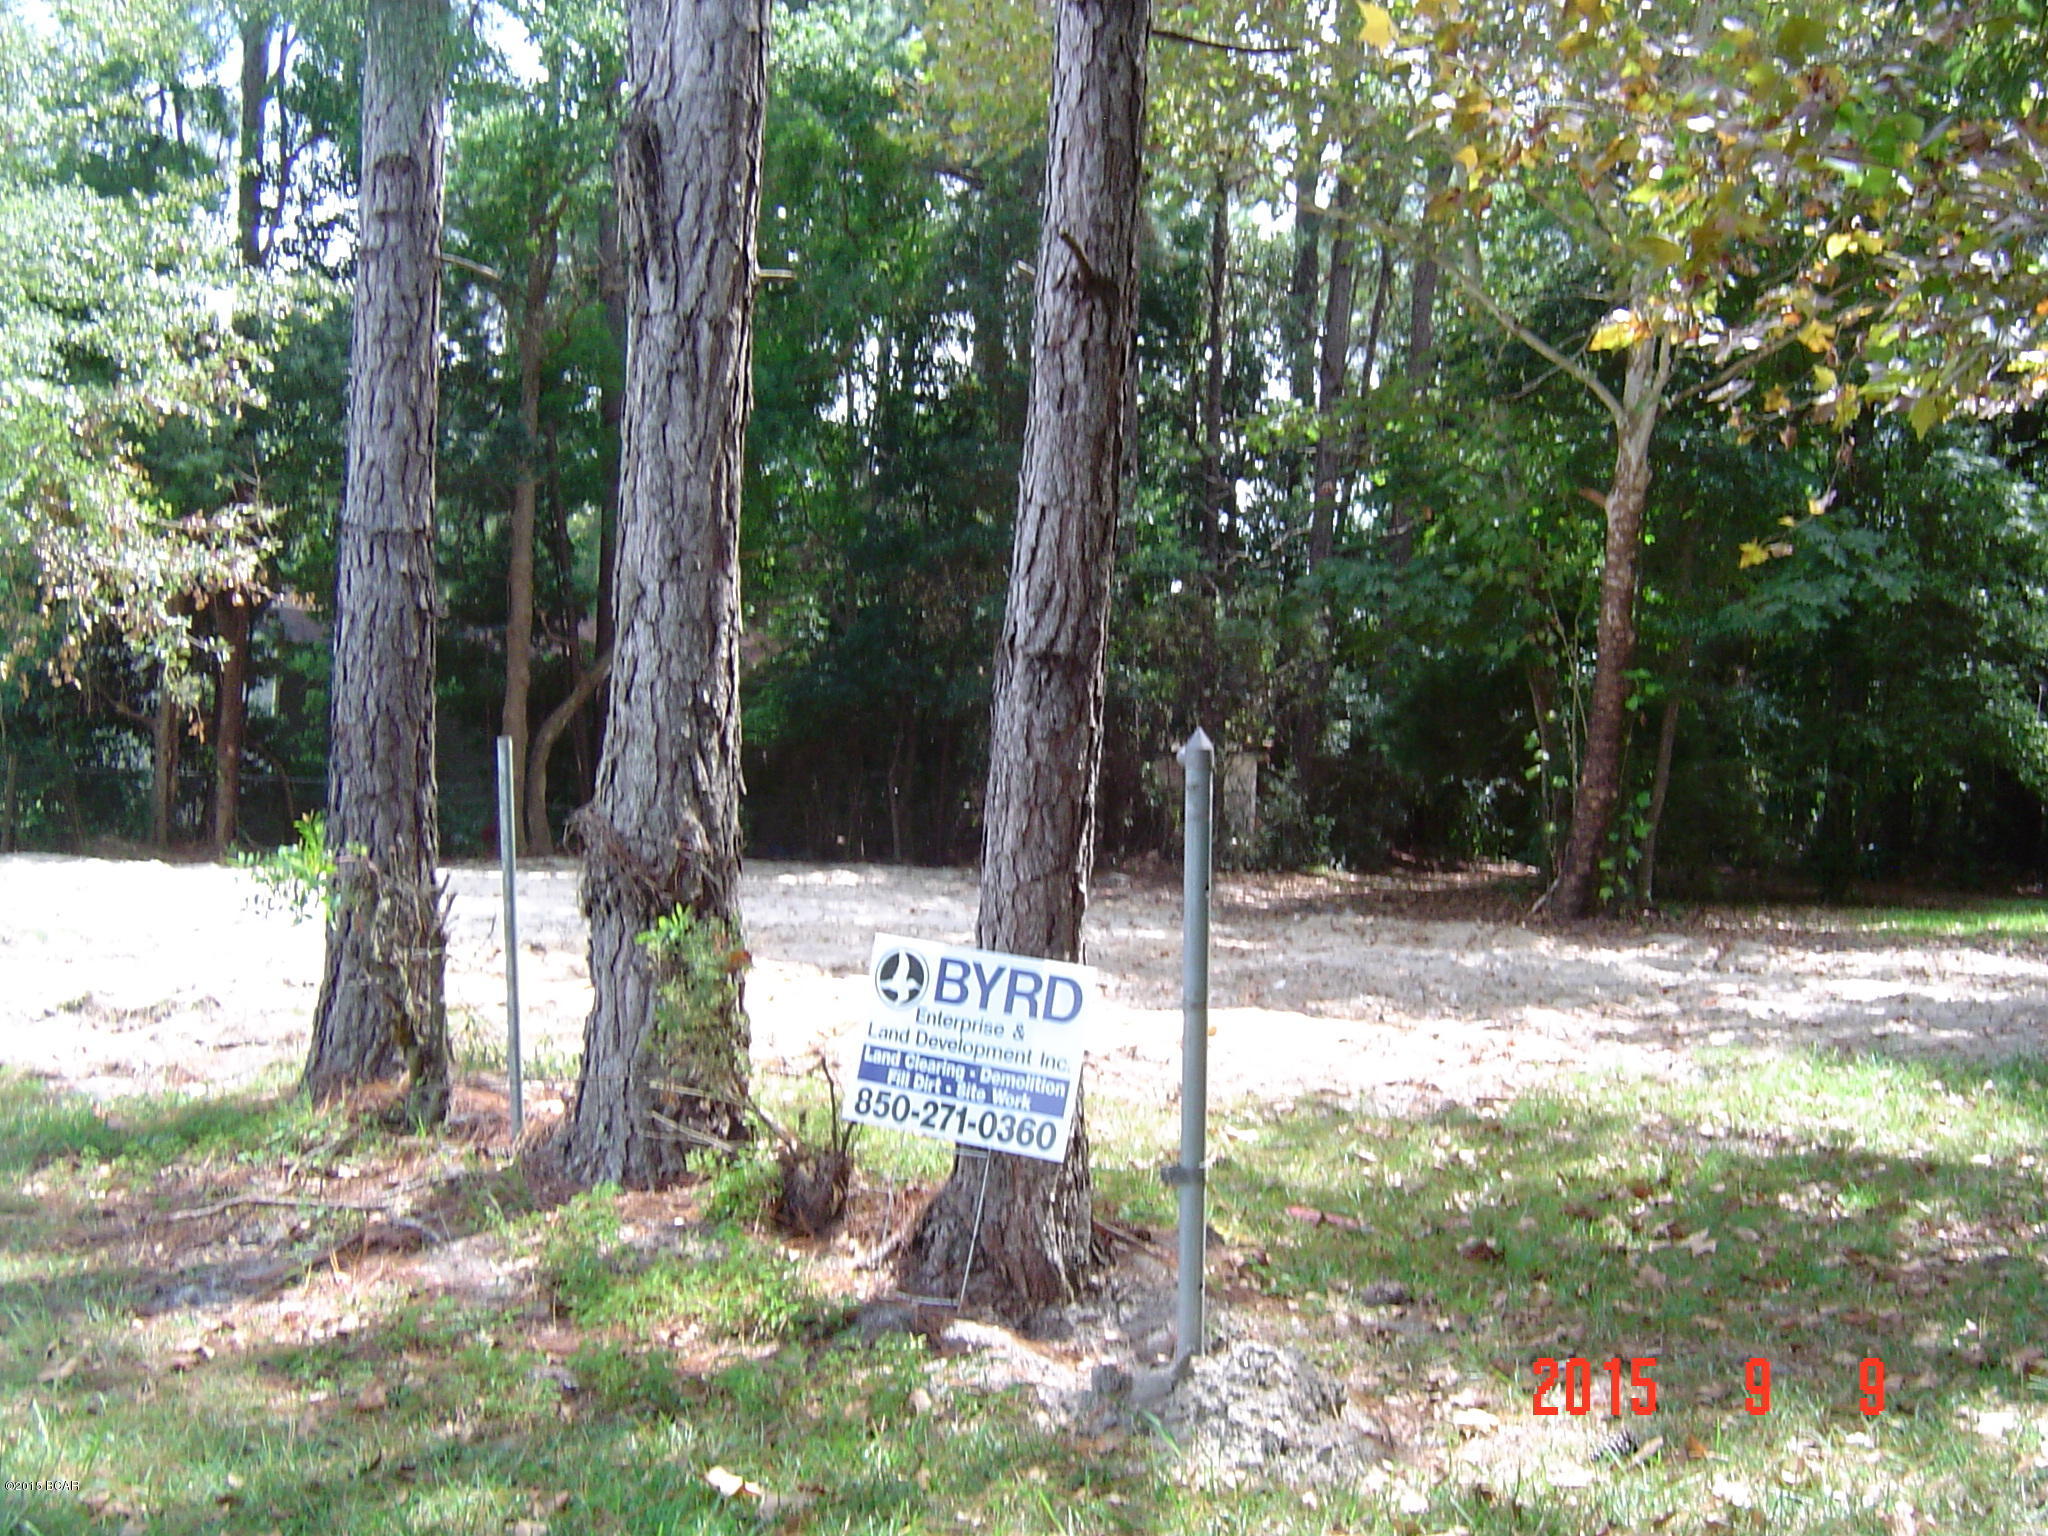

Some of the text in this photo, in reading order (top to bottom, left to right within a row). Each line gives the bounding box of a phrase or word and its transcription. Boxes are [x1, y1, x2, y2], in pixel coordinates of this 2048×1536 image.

[934, 957, 1083, 1024] BYRD
[868, 1022, 910, 1044] Land
[916, 1030, 1032, 1066] Development
[916, 1007, 1025, 1041] Enterprise &
[864, 1044, 1066, 1098] Land Clearing Demolition
[887, 1069, 1031, 1111] Fill Dirt Site Work
[854, 1088, 1057, 1150] 850-271-0360
